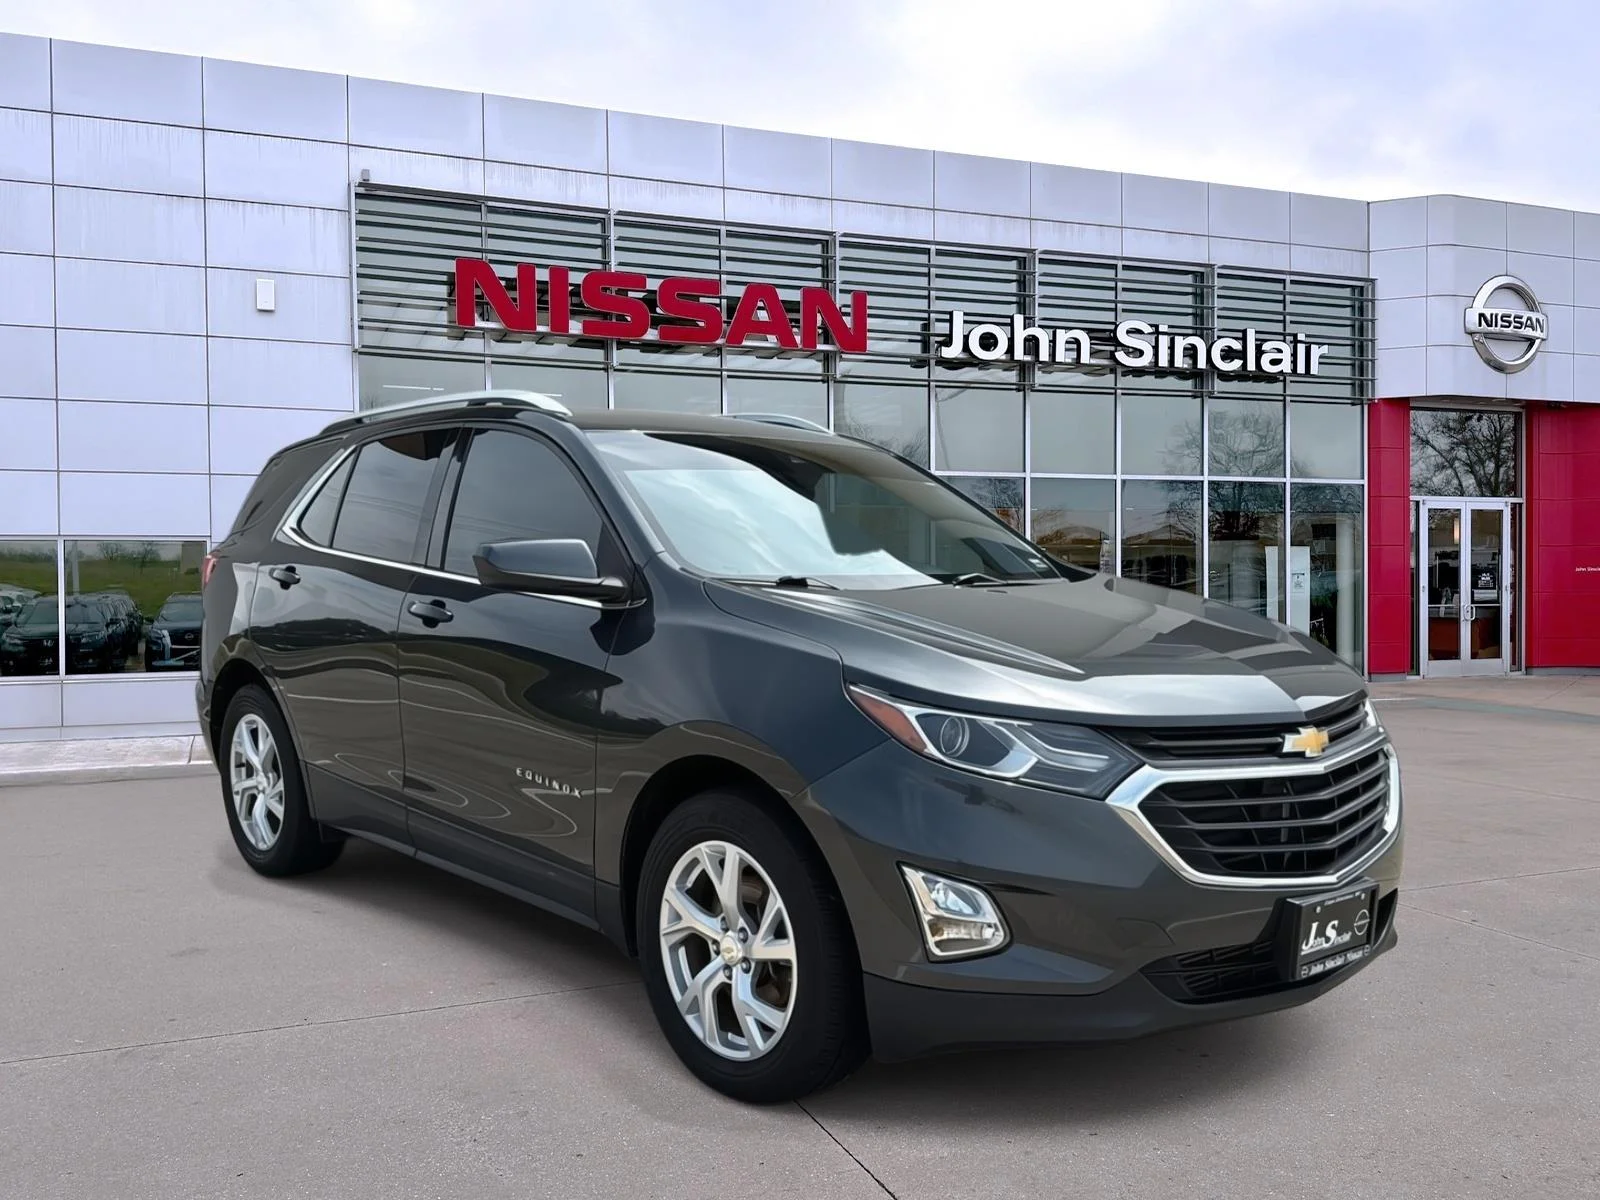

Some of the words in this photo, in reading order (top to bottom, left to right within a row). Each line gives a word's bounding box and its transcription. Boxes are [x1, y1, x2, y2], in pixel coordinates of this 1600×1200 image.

[455, 257, 868, 353] NISSAN
[1477, 312, 1545, 334] NISSAN
[941, 310, 1091, 363] John
[1114, 319, 1329, 375] Sinclair
[515, 767, 582, 799] EQUINOX
